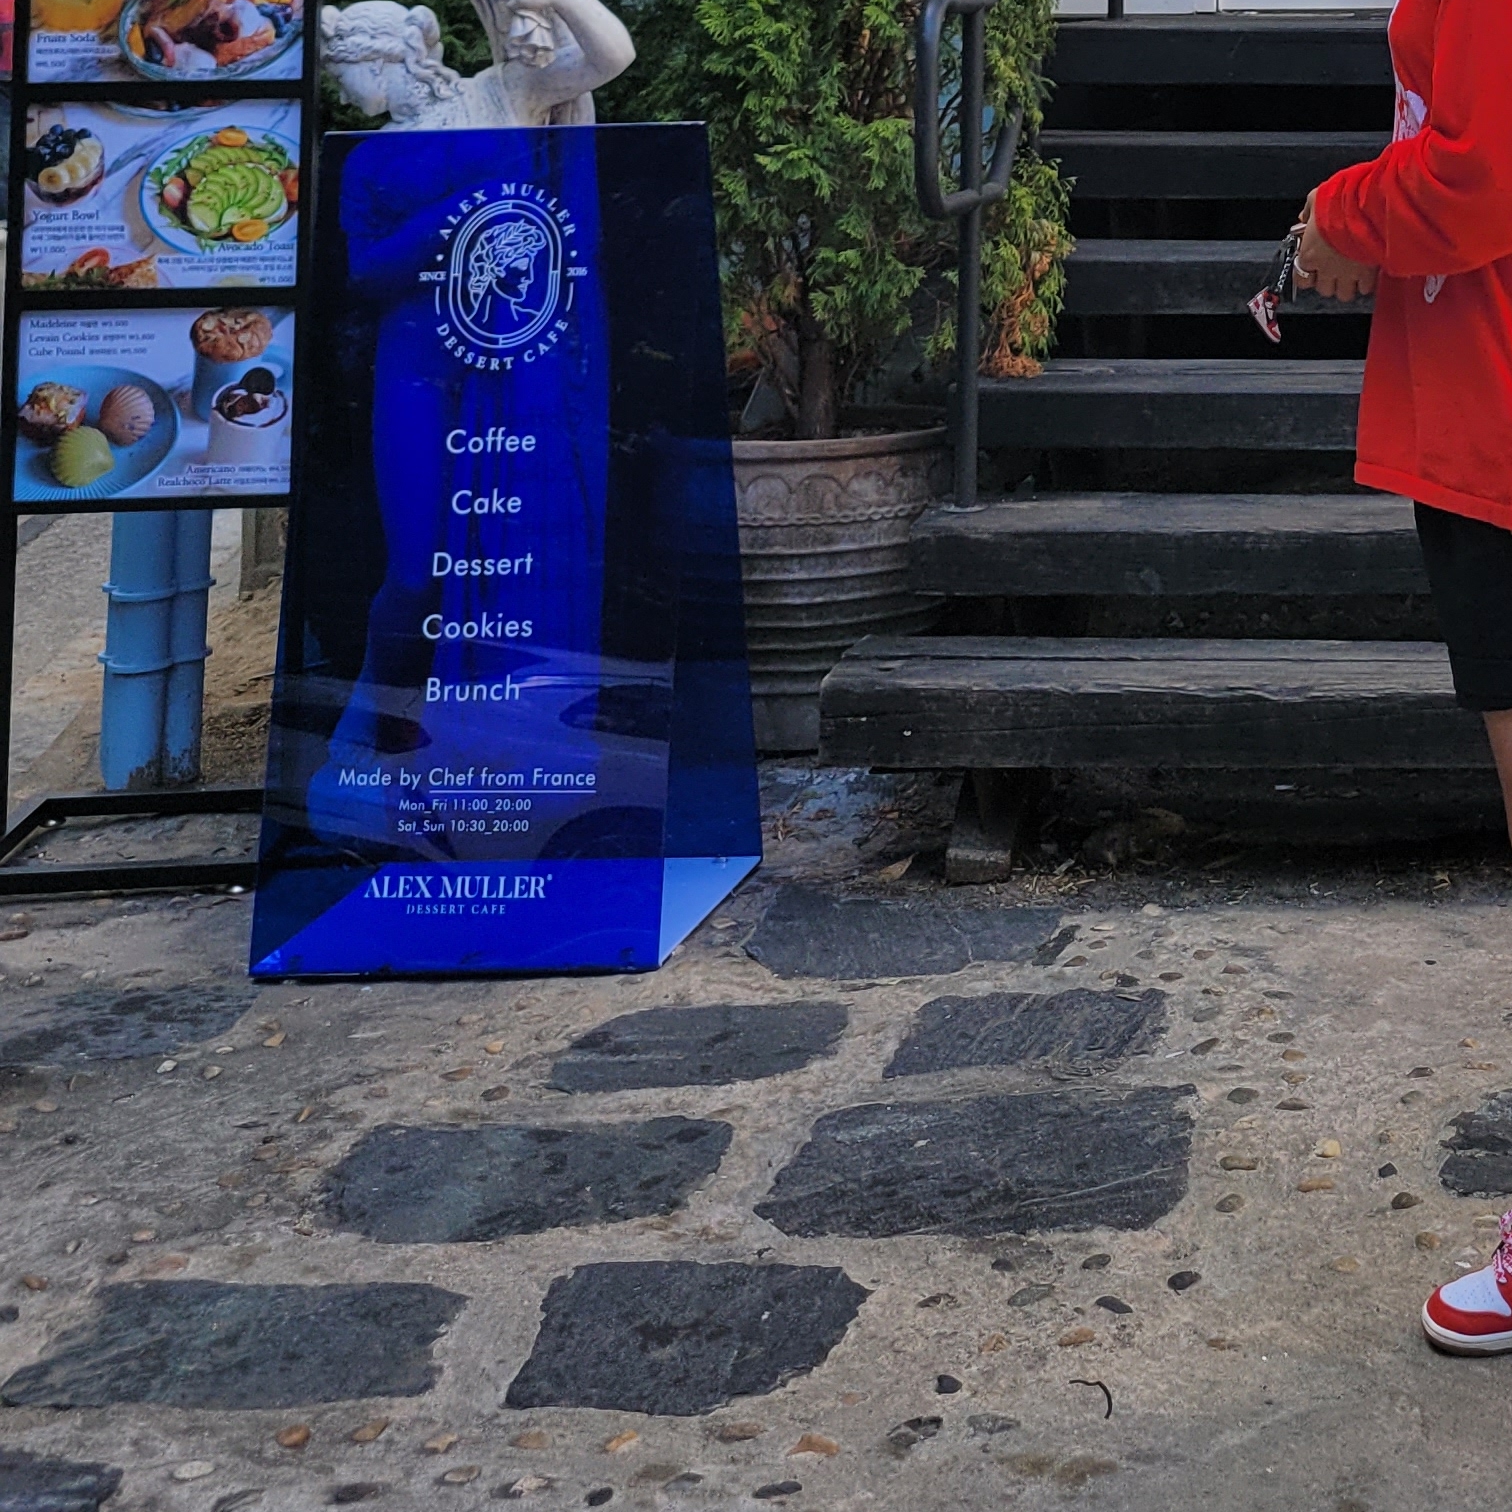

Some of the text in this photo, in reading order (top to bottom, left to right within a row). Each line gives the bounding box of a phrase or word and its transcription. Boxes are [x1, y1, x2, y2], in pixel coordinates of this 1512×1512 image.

[33, 209, 100, 223] Yogurt Bowl
[439, 182, 577, 240] ALEX MULLER
[418, 266, 589, 282] SINCE 2016
[62, 332, 100, 341] Cookies
[436, 319, 569, 371] DESSERT CAFE
[445, 427, 537, 454] Coffee
[186, 465, 236, 474] Americano
[451, 488, 522, 515] Cake
[432, 552, 534, 577] Dessert
[422, 612, 533, 639] Cookies
[426, 674, 521, 702] Brunch
[338, 767, 596, 790] Made by Chef from France
[398, 798, 532, 813] Mon_Fri 11:00_20:00
[397, 819, 529, 834] Sat_Sun 10:30_20:00
[363, 875, 546, 898] ALEX MULLER
[406, 904, 506, 915] DESSERT CAFE
